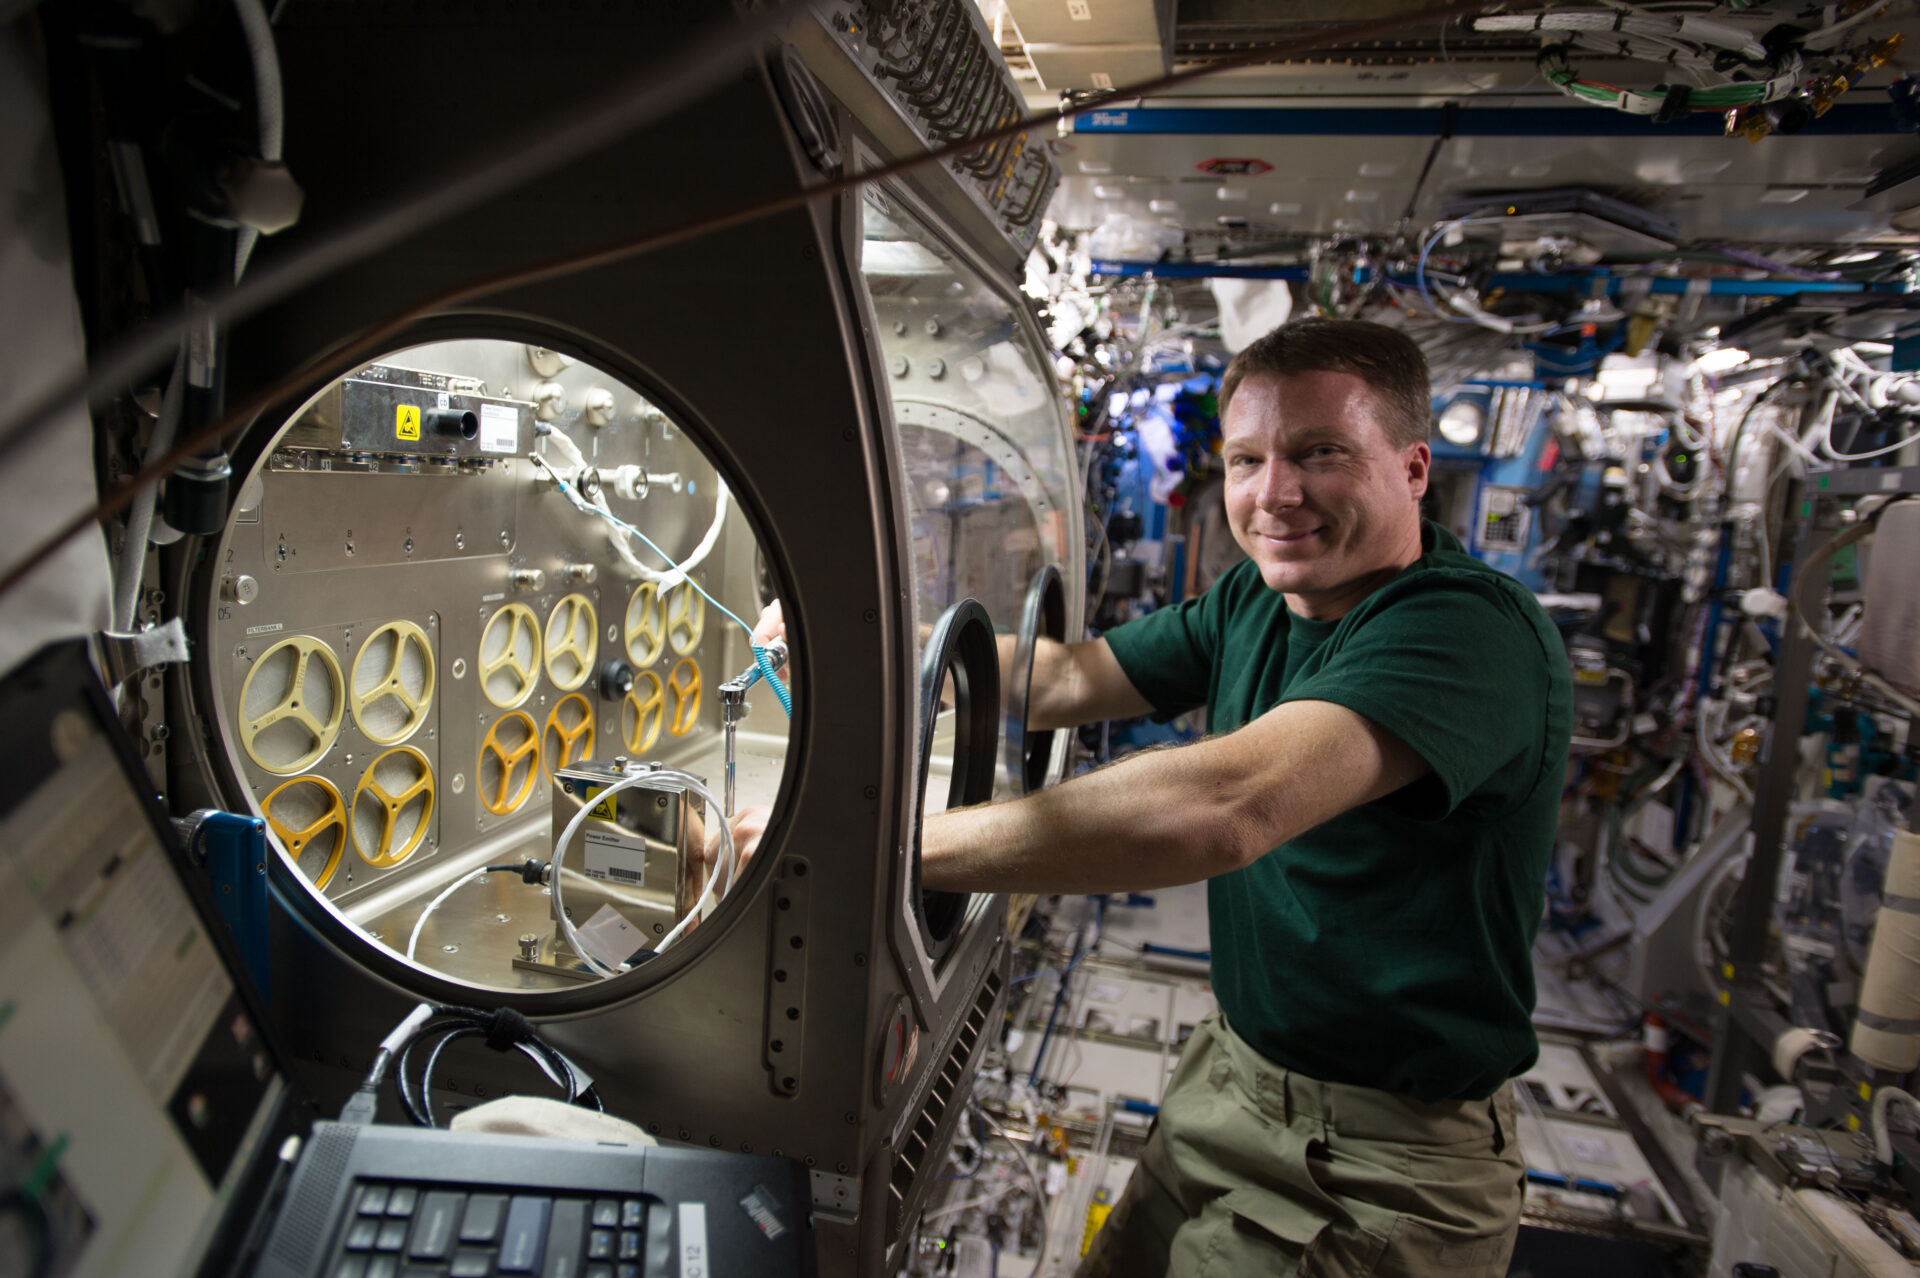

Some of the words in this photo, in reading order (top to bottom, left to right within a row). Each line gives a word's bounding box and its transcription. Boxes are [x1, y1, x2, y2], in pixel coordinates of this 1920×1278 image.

[321, 460, 331, 470] J1
[369, 462, 379, 472] J2
[279, 533, 285, 541] A
[347, 530, 353, 538] B
[602, 835, 620, 843] Emitter
[687, 1245, 701, 1261] 12
